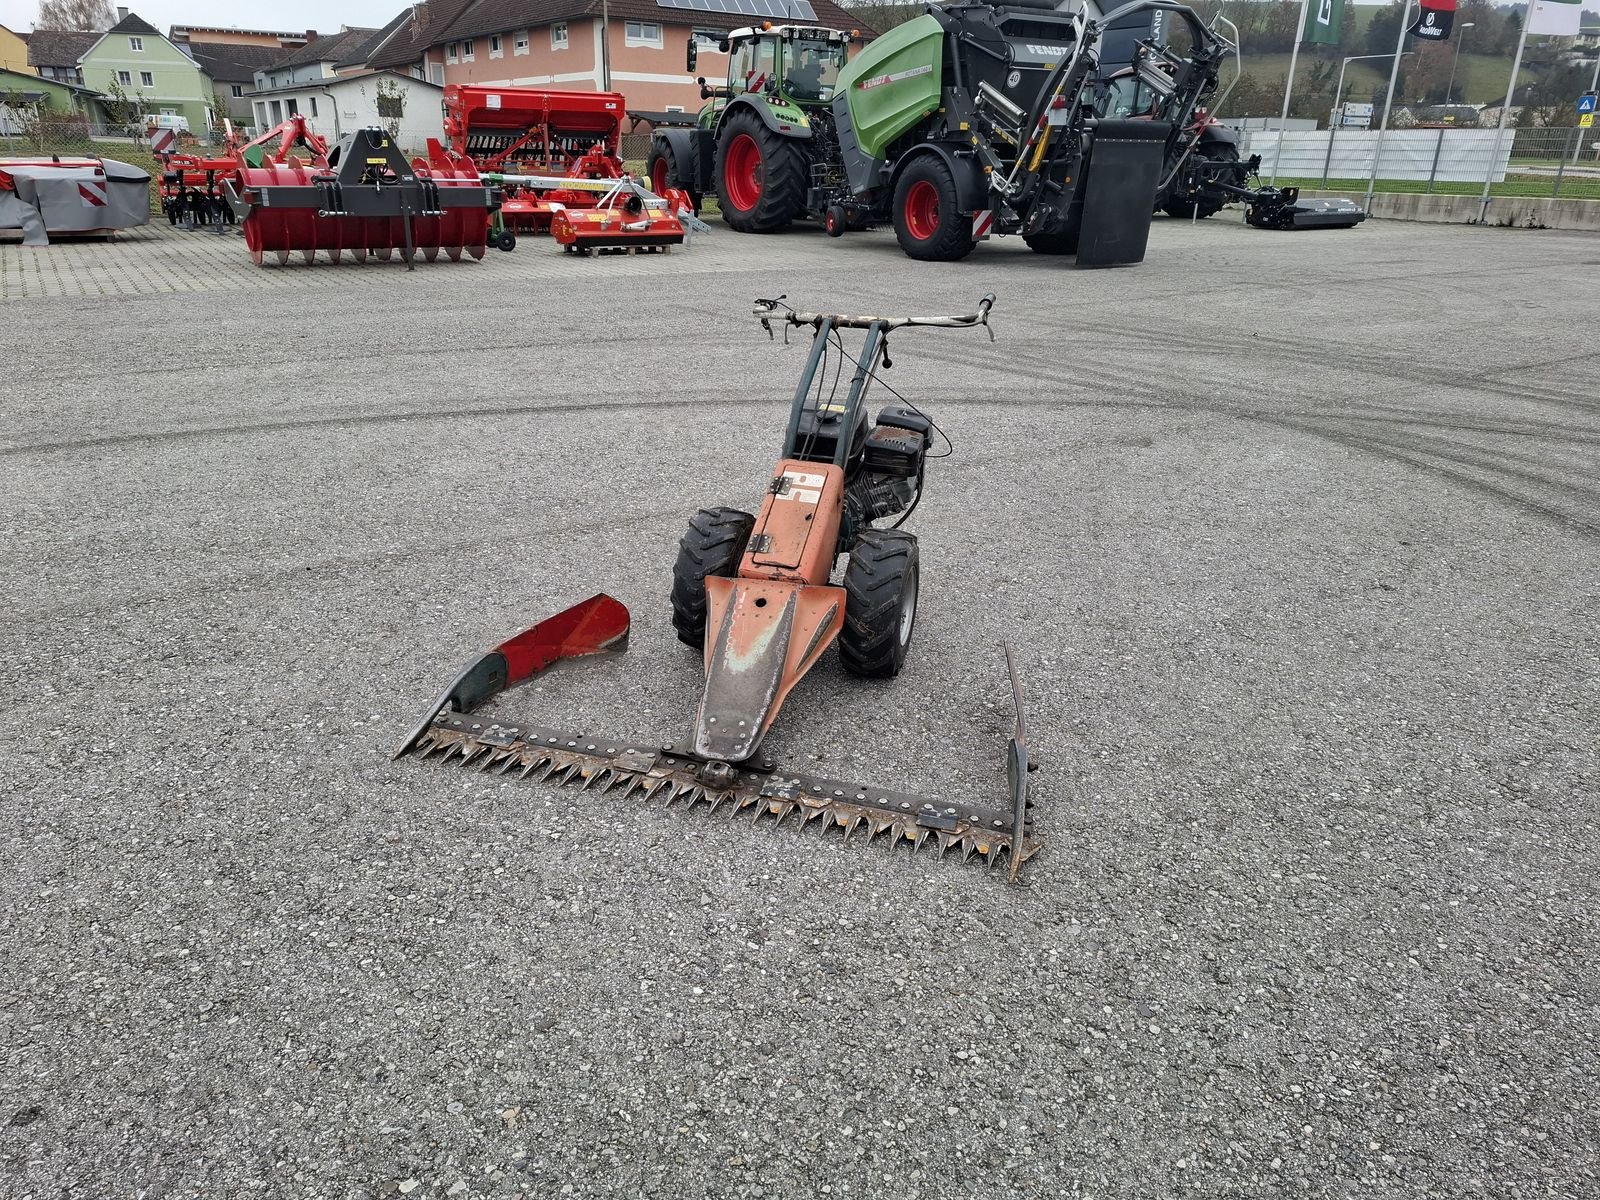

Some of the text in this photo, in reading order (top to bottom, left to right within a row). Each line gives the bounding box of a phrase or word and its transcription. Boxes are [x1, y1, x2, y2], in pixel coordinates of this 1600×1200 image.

[1026, 44, 1068, 56] FENDT
[863, 74, 888, 89] FENDT
[1009, 74, 1019, 83] 40
